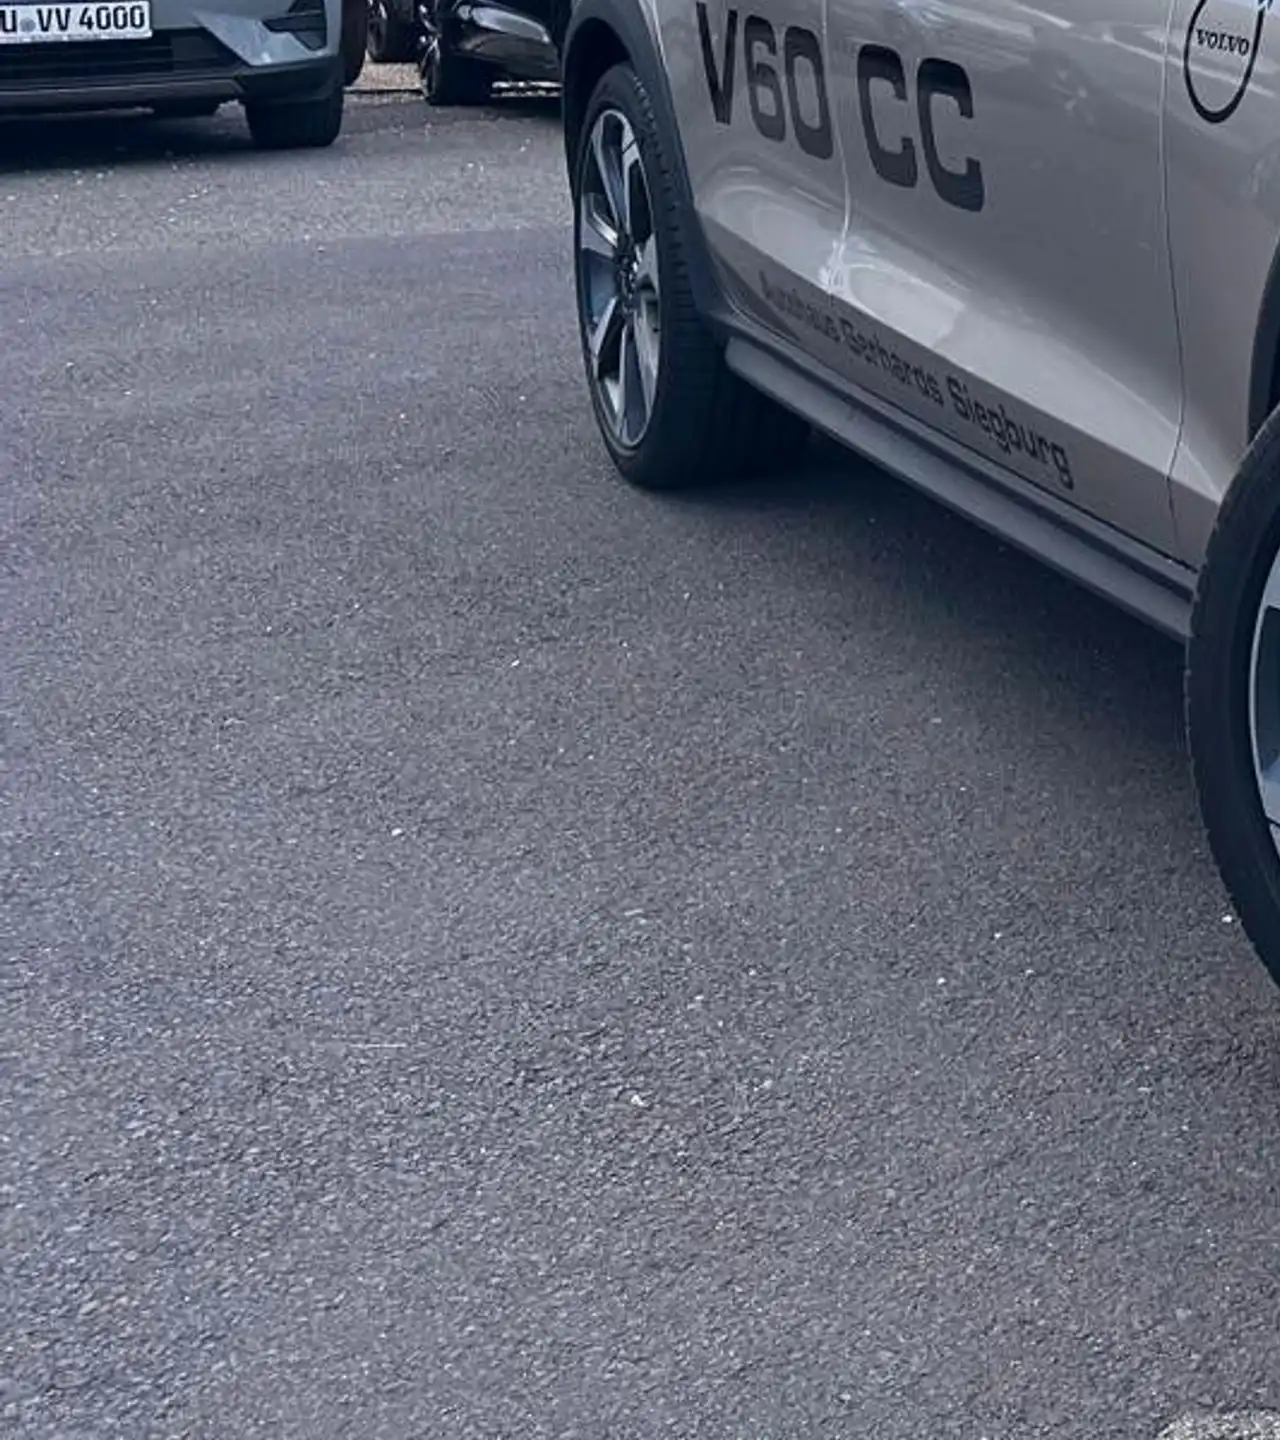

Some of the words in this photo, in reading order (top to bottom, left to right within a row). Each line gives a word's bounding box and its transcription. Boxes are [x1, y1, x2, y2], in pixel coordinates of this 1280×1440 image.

[36, 7, 71, 32] VV
[79, 5, 146, 31] 4000
[1196, 29, 1250, 56] VOLVO
[696, 0, 835, 161] V60
[857, 43, 986, 213] CC
